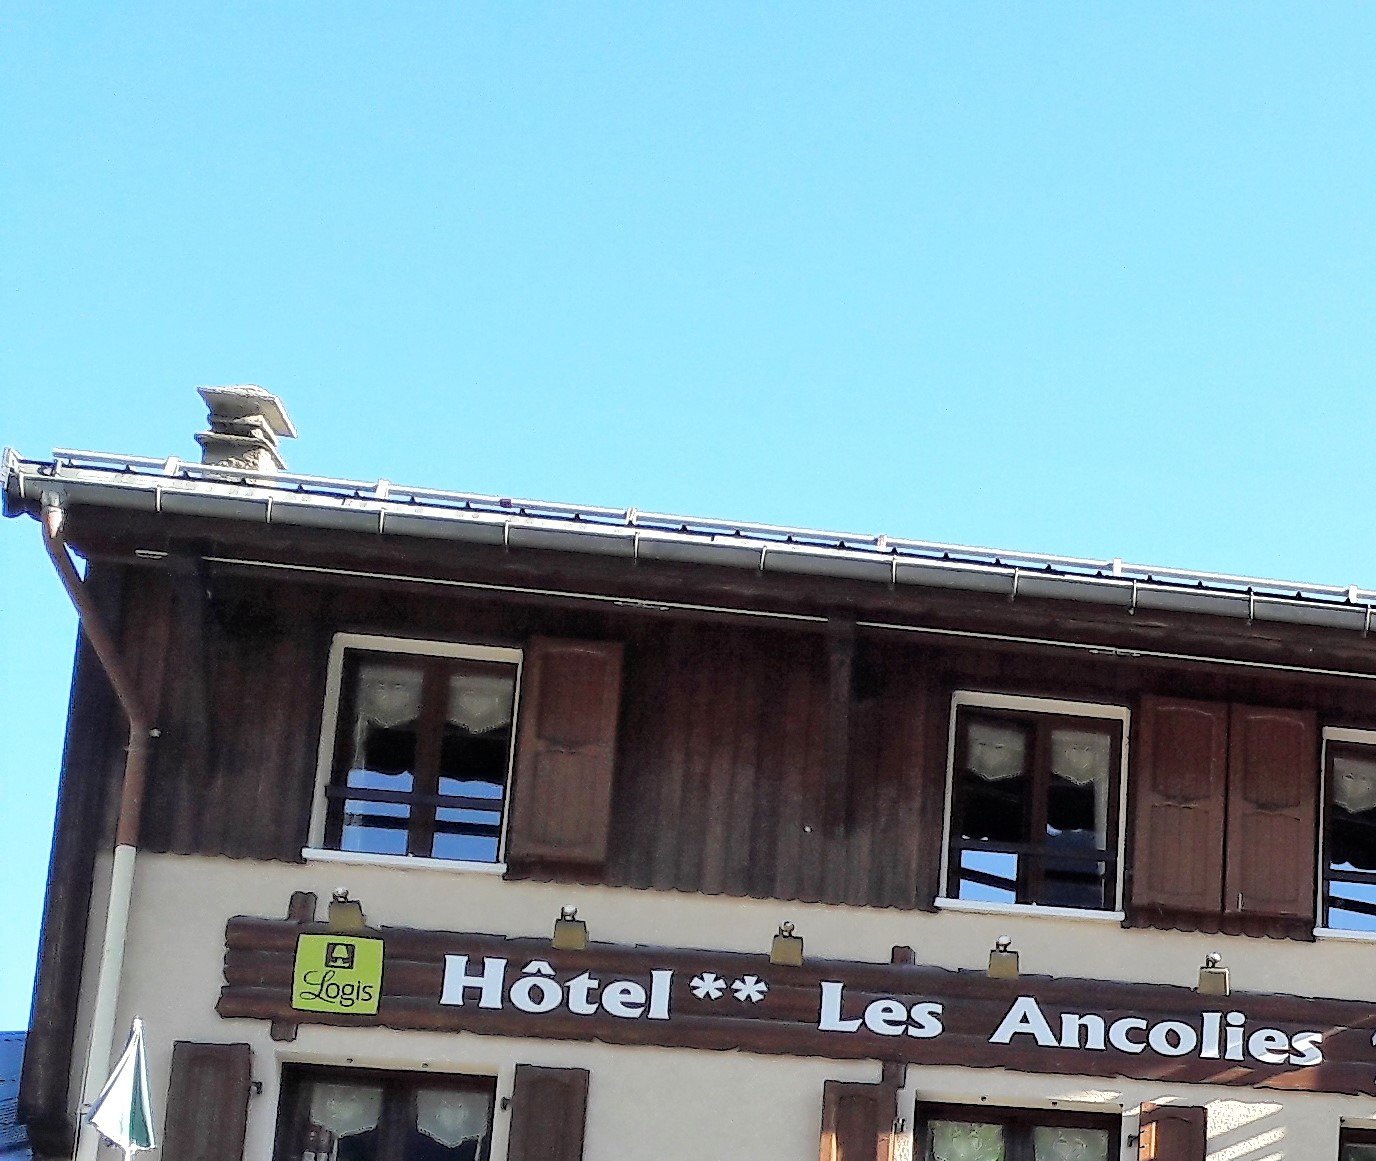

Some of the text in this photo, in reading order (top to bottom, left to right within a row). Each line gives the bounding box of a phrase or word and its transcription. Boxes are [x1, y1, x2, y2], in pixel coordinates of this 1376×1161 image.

[299, 969, 374, 1008] Logis
[438, 953, 675, 1020] Hôtel
[817, 980, 944, 1039] Les
[989, 996, 1323, 1067] Ancolies
